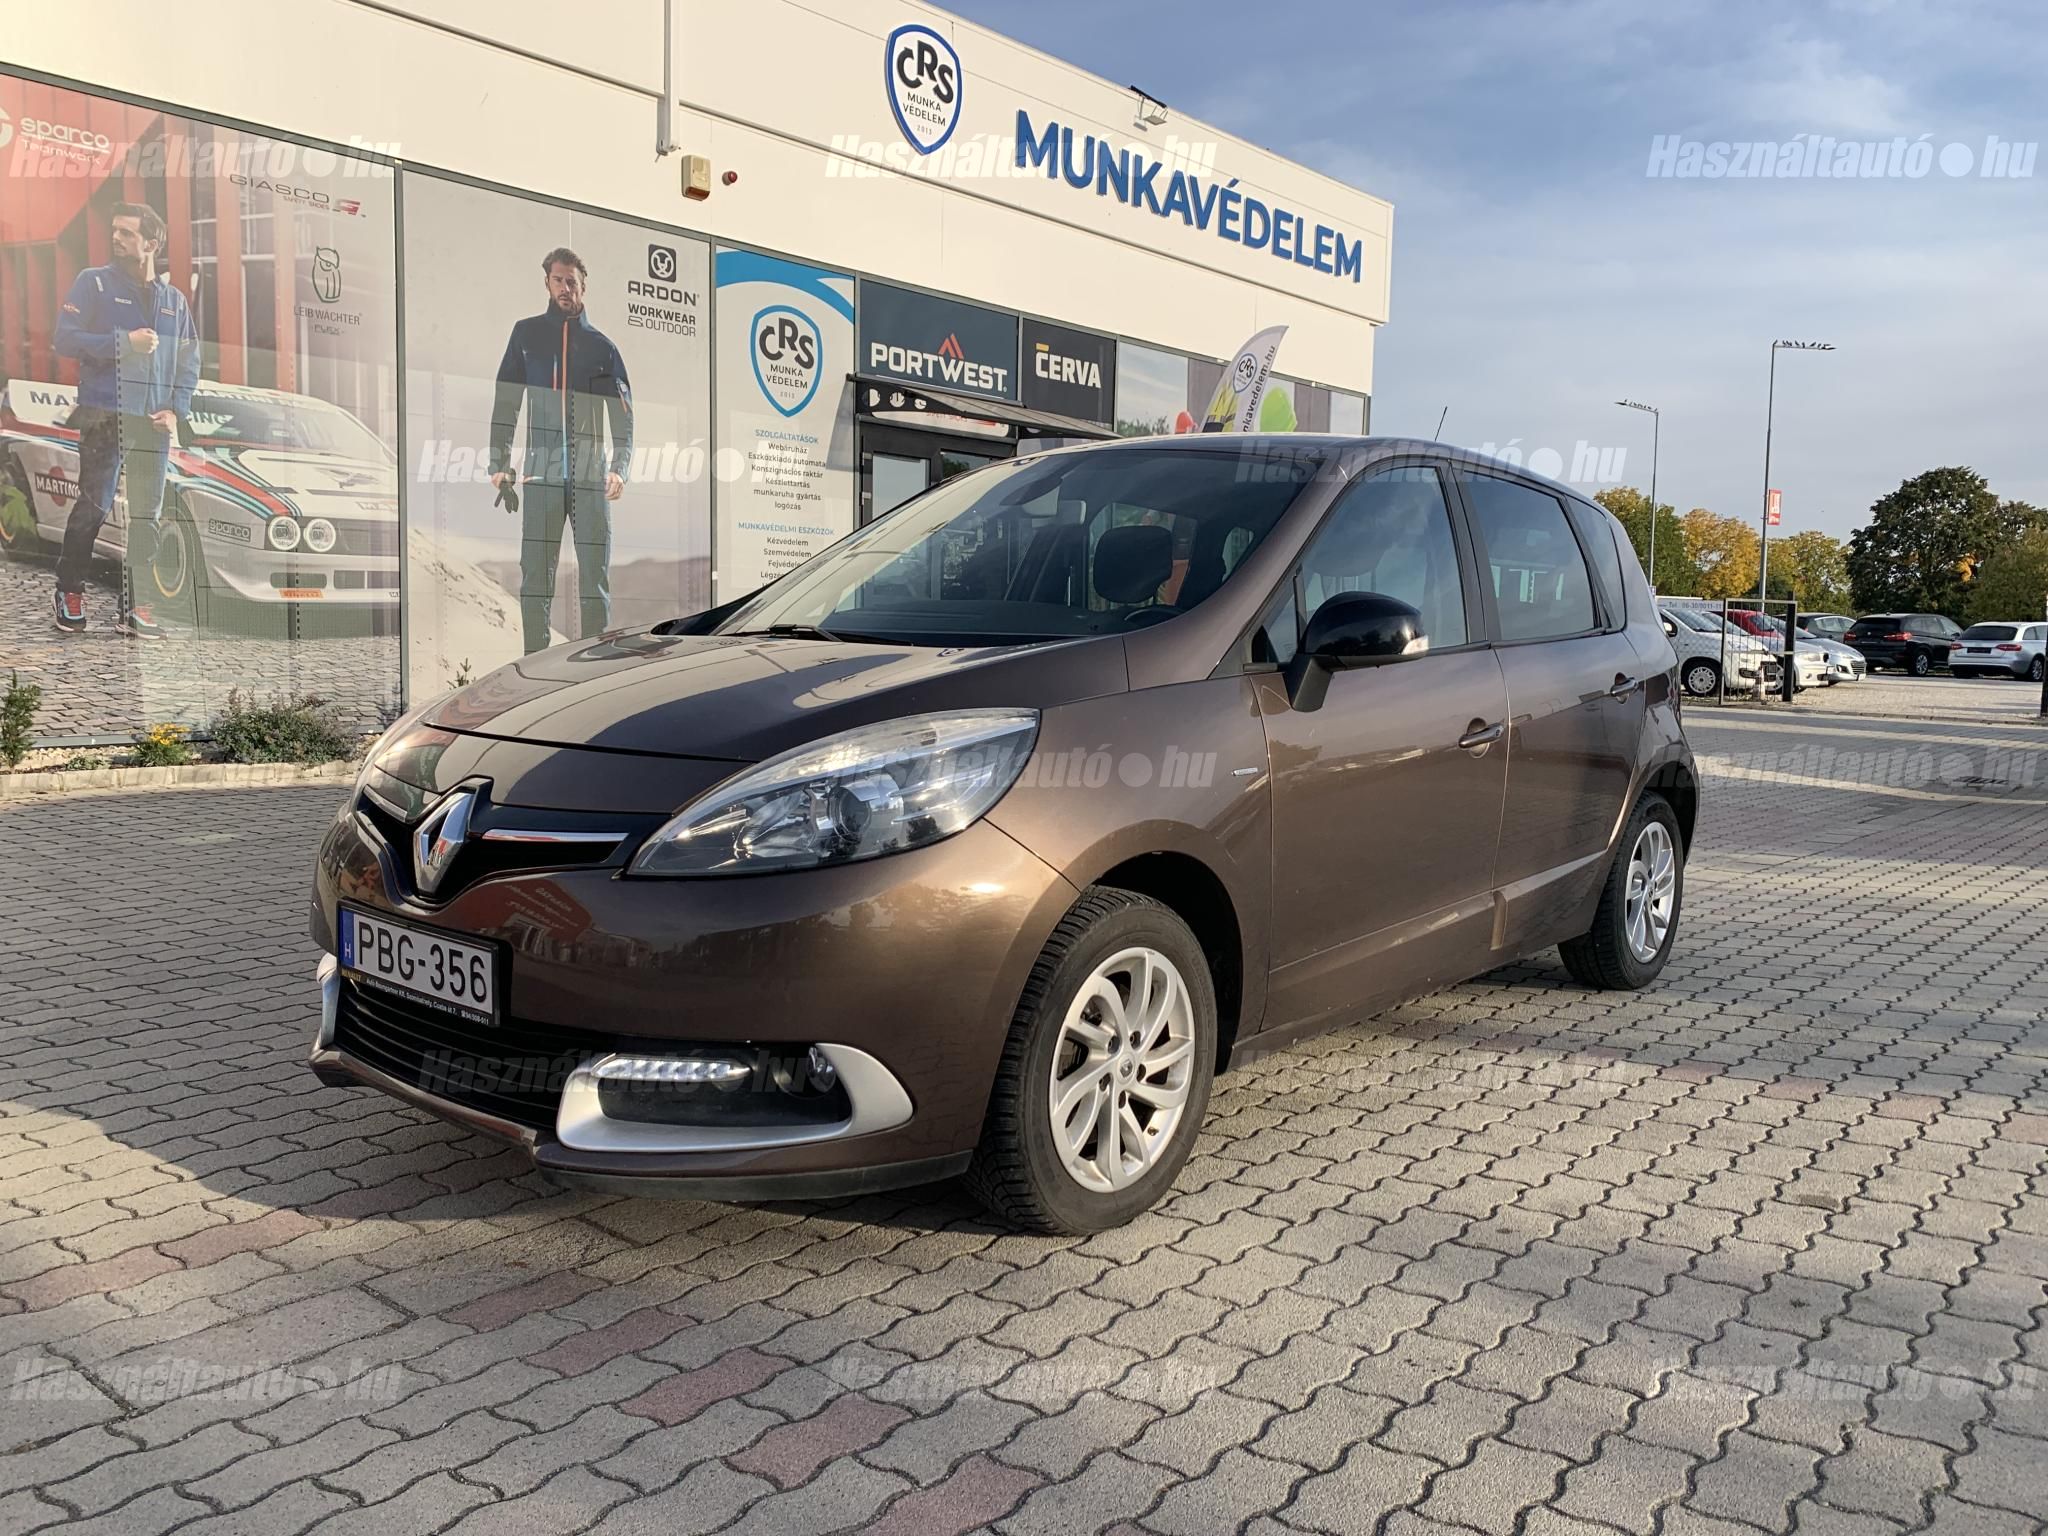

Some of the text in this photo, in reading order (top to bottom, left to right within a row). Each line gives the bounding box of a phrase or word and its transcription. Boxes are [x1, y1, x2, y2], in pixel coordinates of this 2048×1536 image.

[897, 40, 954, 104] CRS
[907, 92, 942, 112] MUNKA
[902, 103, 946, 127] VÉDELEM
[20, 117, 110, 149] sparco
[229, 174, 330, 204] GIASCO
[1015, 108, 1362, 284] MUNKAVÉDELEM
[627, 280, 696, 307] ARDON
[627, 302, 696, 326] WORKWEAR
[645, 318, 696, 337] OUTDOOR
[759, 317, 815, 370] CRS
[770, 364, 804, 377] MUNKA
[870, 341, 1008, 392] PORTWEST
[766, 373, 808, 389] VÉDELEM
[1243, 345, 1276, 433] nkavedelem.hu
[793, 458, 826, 468] automata
[803, 470, 823, 479] raktár
[753, 488, 822, 501] munkaruha gyártás
[763, 548, 812, 558] Szemvédelem
[768, 560, 801, 569] Fejvédele
[358, 921, 487, 1003] PBG-356
